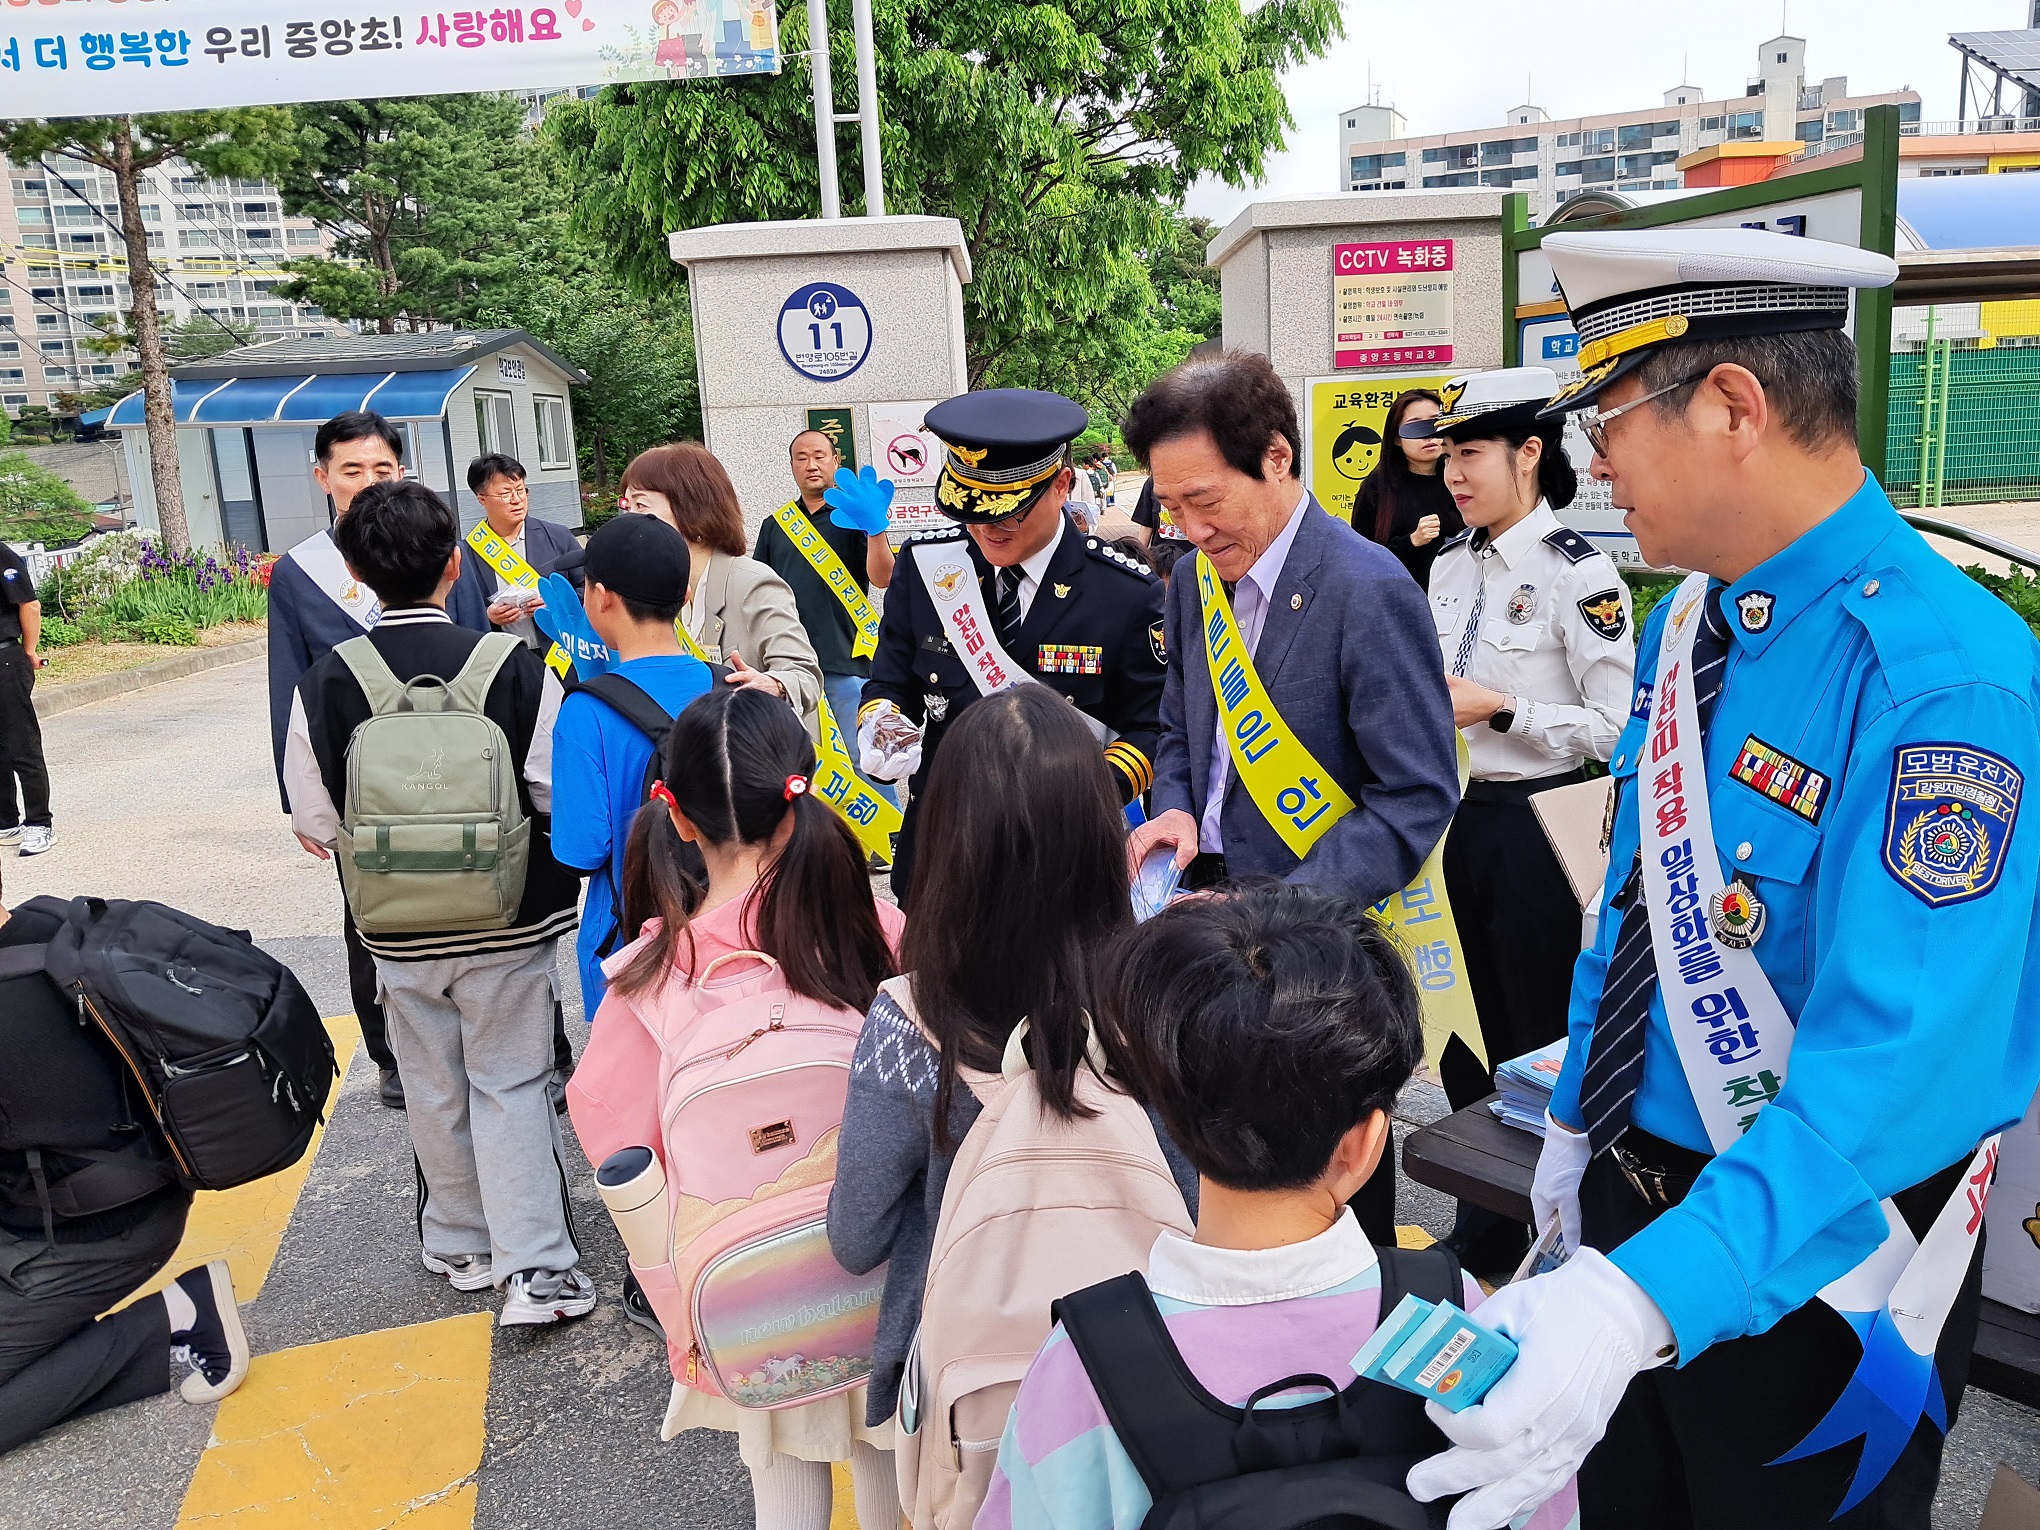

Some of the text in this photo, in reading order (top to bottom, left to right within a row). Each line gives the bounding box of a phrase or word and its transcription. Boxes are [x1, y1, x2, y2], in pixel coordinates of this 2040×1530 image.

[34, 35, 68, 70] 더
[79, 29, 191, 71] 행복한
[203, 24, 271, 64] 우리
[284, 15, 403, 59] 중앙초!
[415, 8, 562, 48] 사랑해요
[1340, 246, 1447, 269] CCTV 녹화중
[807, 322, 844, 350] 11
[796, 351, 858, 363] 번영로105번길
[1359, 350, 1435, 363] 중앙초등학교장
[1331, 493, 1352, 501] 여기는
[472, 527, 535, 587] 어린이는
[781, 507, 829, 564] 어린이는
[829, 567, 879, 637] 안전보행
[1605, 550, 1640, 563] 등학교
[1602, 622, 1621, 631] POLICE
[578, 637, 610, 661] 먼저
[952, 603, 1006, 688] 안전띠 착용
[1200, 562, 1331, 832] 어른들은 안
[1652, 660, 1681, 763] 안전띠
[1906, 753, 2018, 794] 모범운전자
[815, 759, 879, 826] 보행
[1651, 762, 1688, 838] 착용
[1920, 782, 1998, 808] 강원지방경찰청
[1934, 873, 1969, 886] DRIVER
[1660, 838, 1725, 984] 일상화를
[1690, 987, 1762, 1065] 위한
[741, 1314, 796, 1346] new
